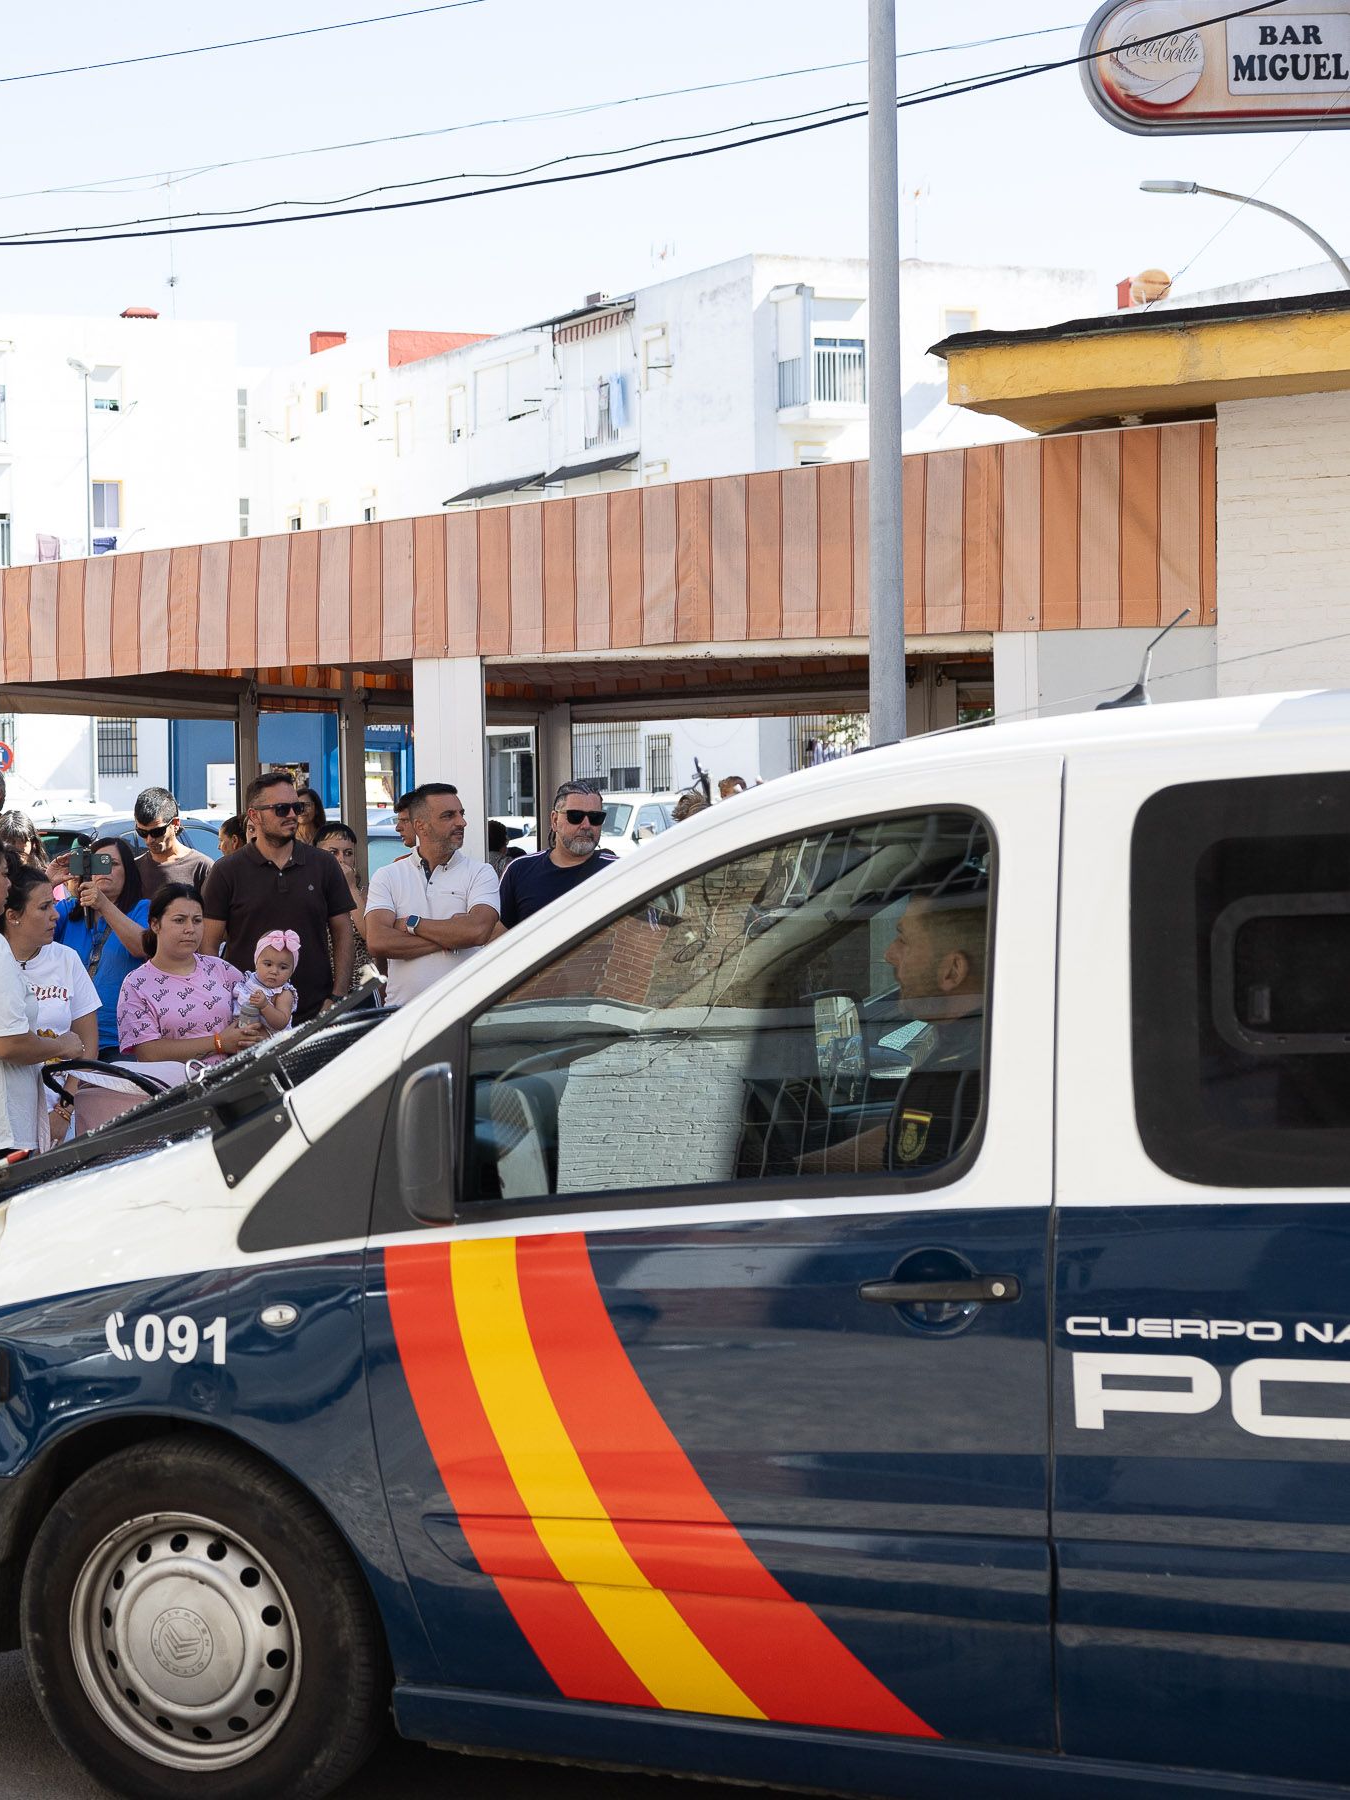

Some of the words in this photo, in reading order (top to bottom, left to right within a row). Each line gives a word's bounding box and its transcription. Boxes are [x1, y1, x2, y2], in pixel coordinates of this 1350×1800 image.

[1258, 25, 1323, 46] BAR
[1232, 53, 1350, 82] MIGUEL
[134, 1313, 227, 1365] 091
[1066, 1316, 1284, 1341] CUERPO
[1072, 1352, 1350, 1440] PO
